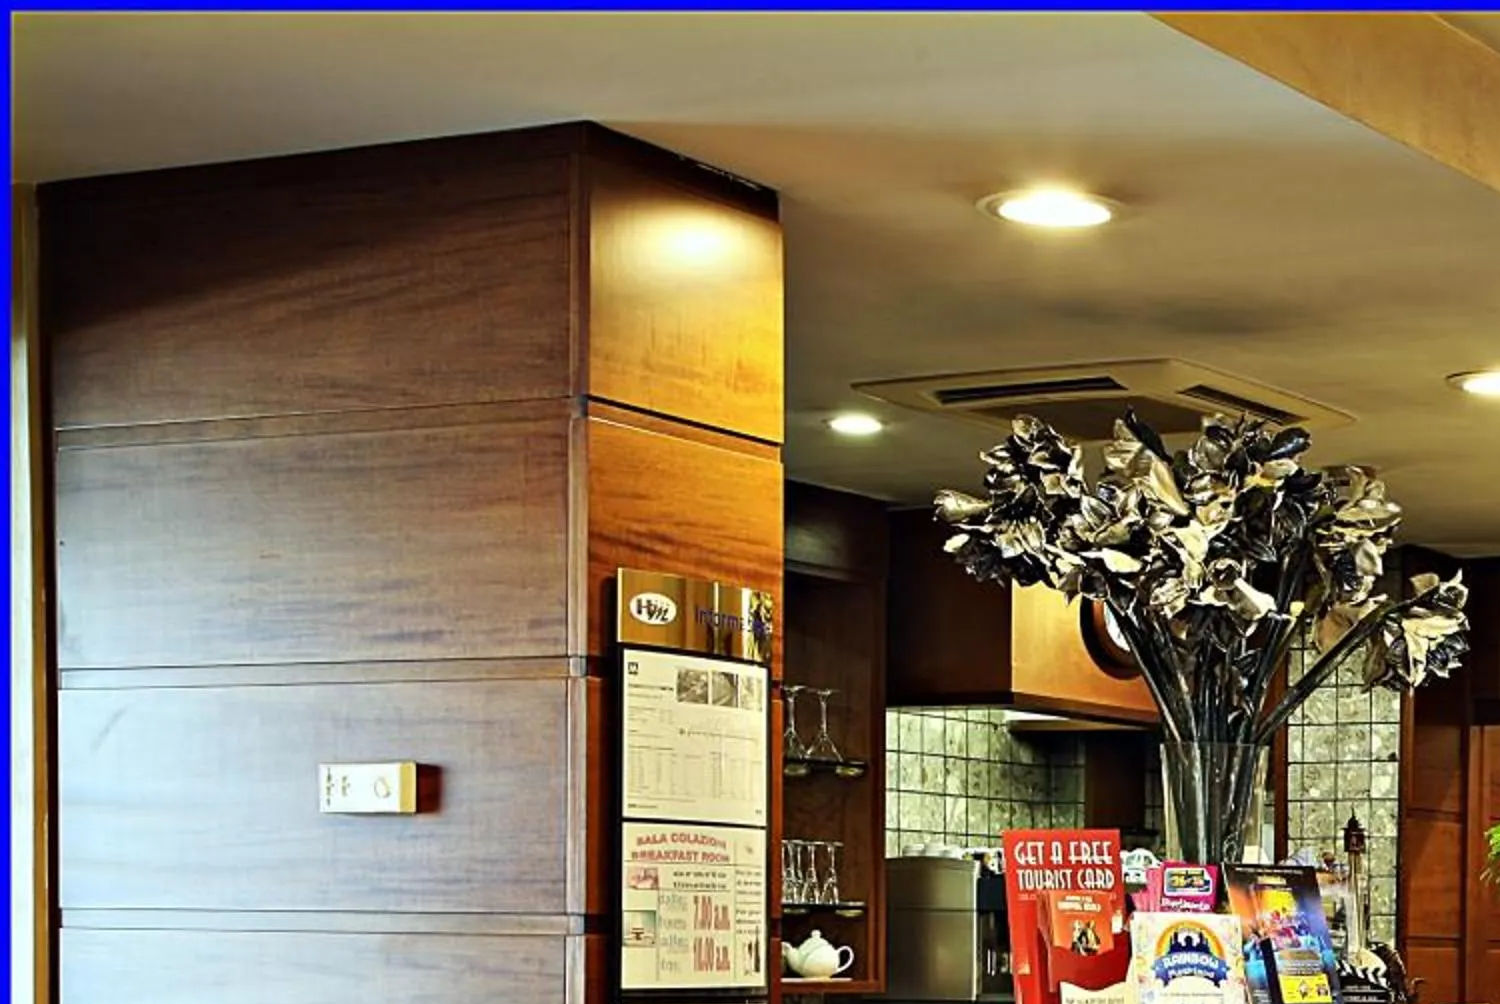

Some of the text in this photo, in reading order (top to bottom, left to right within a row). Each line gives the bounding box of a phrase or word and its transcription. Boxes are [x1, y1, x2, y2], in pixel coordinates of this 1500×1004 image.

[1014, 841, 1113, 865] GET A FREE
[1017, 868, 1116, 891] TOURIST CARD
[1162, 951, 1220, 970] RAINBOW
